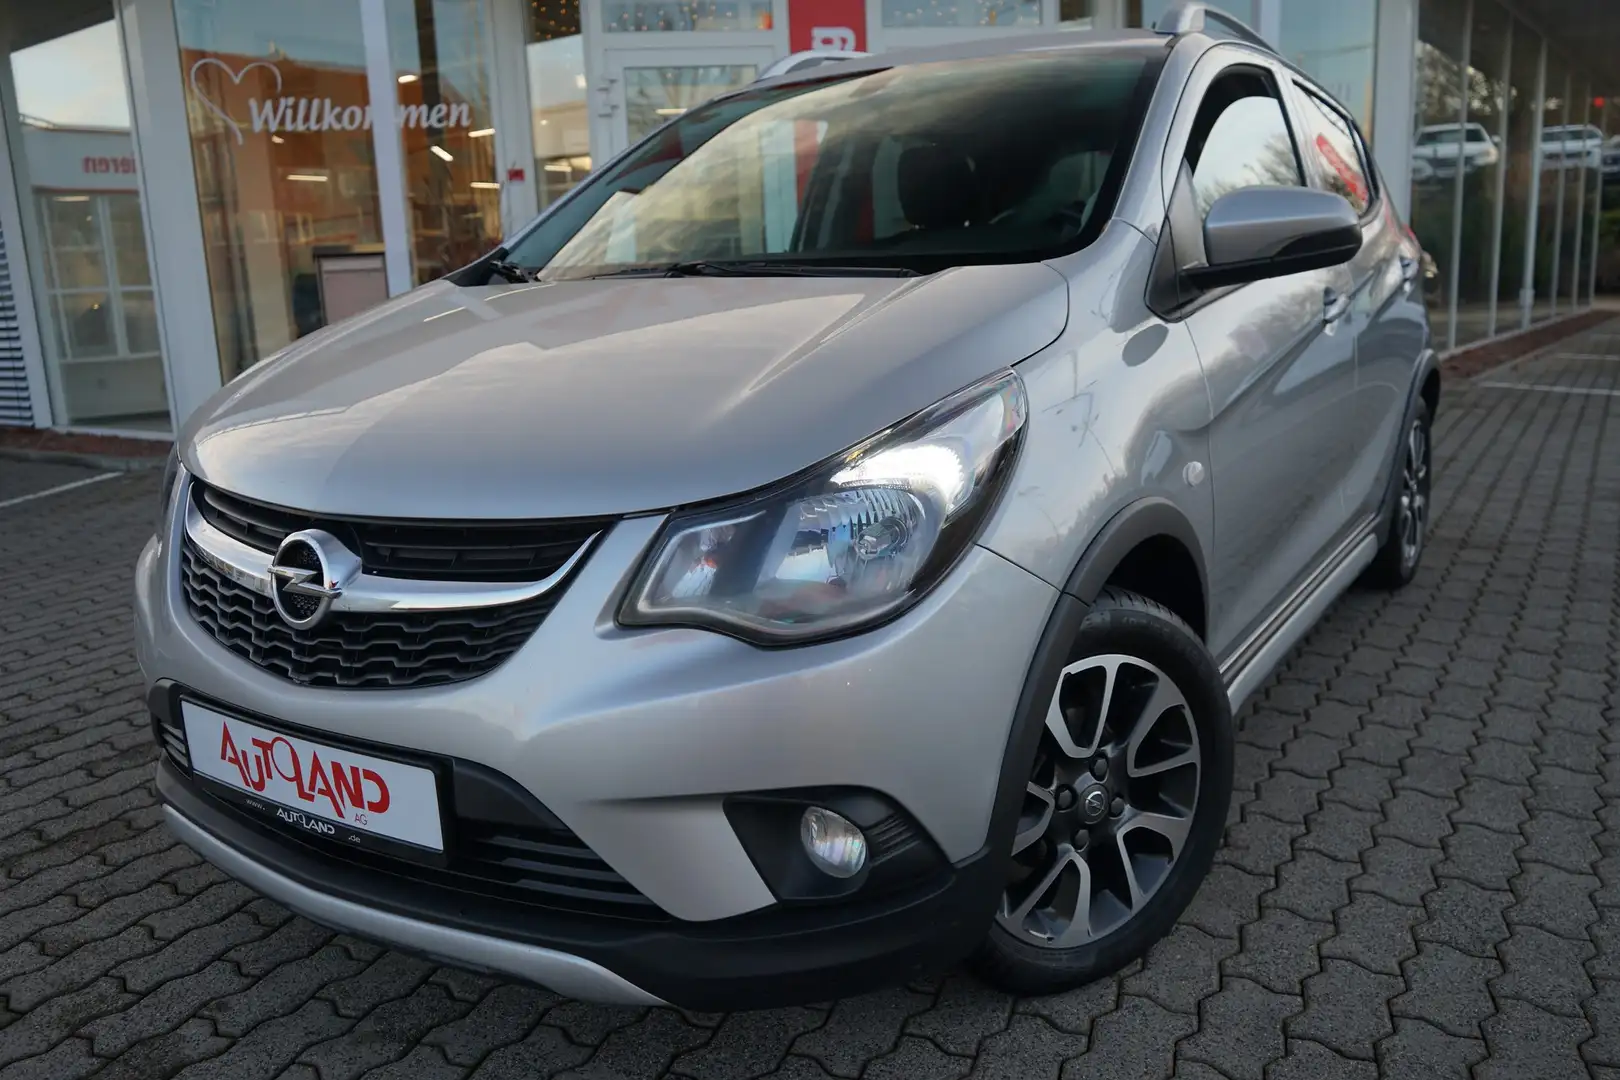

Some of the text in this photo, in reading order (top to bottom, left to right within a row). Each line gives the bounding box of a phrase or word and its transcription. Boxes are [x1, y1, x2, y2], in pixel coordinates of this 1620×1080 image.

[248, 96, 472, 133] Willkomen
[220, 720, 391, 819] AUTOLAND
[276, 807, 336, 835] AUTOLAND
[354, 812, 368, 826] AG
